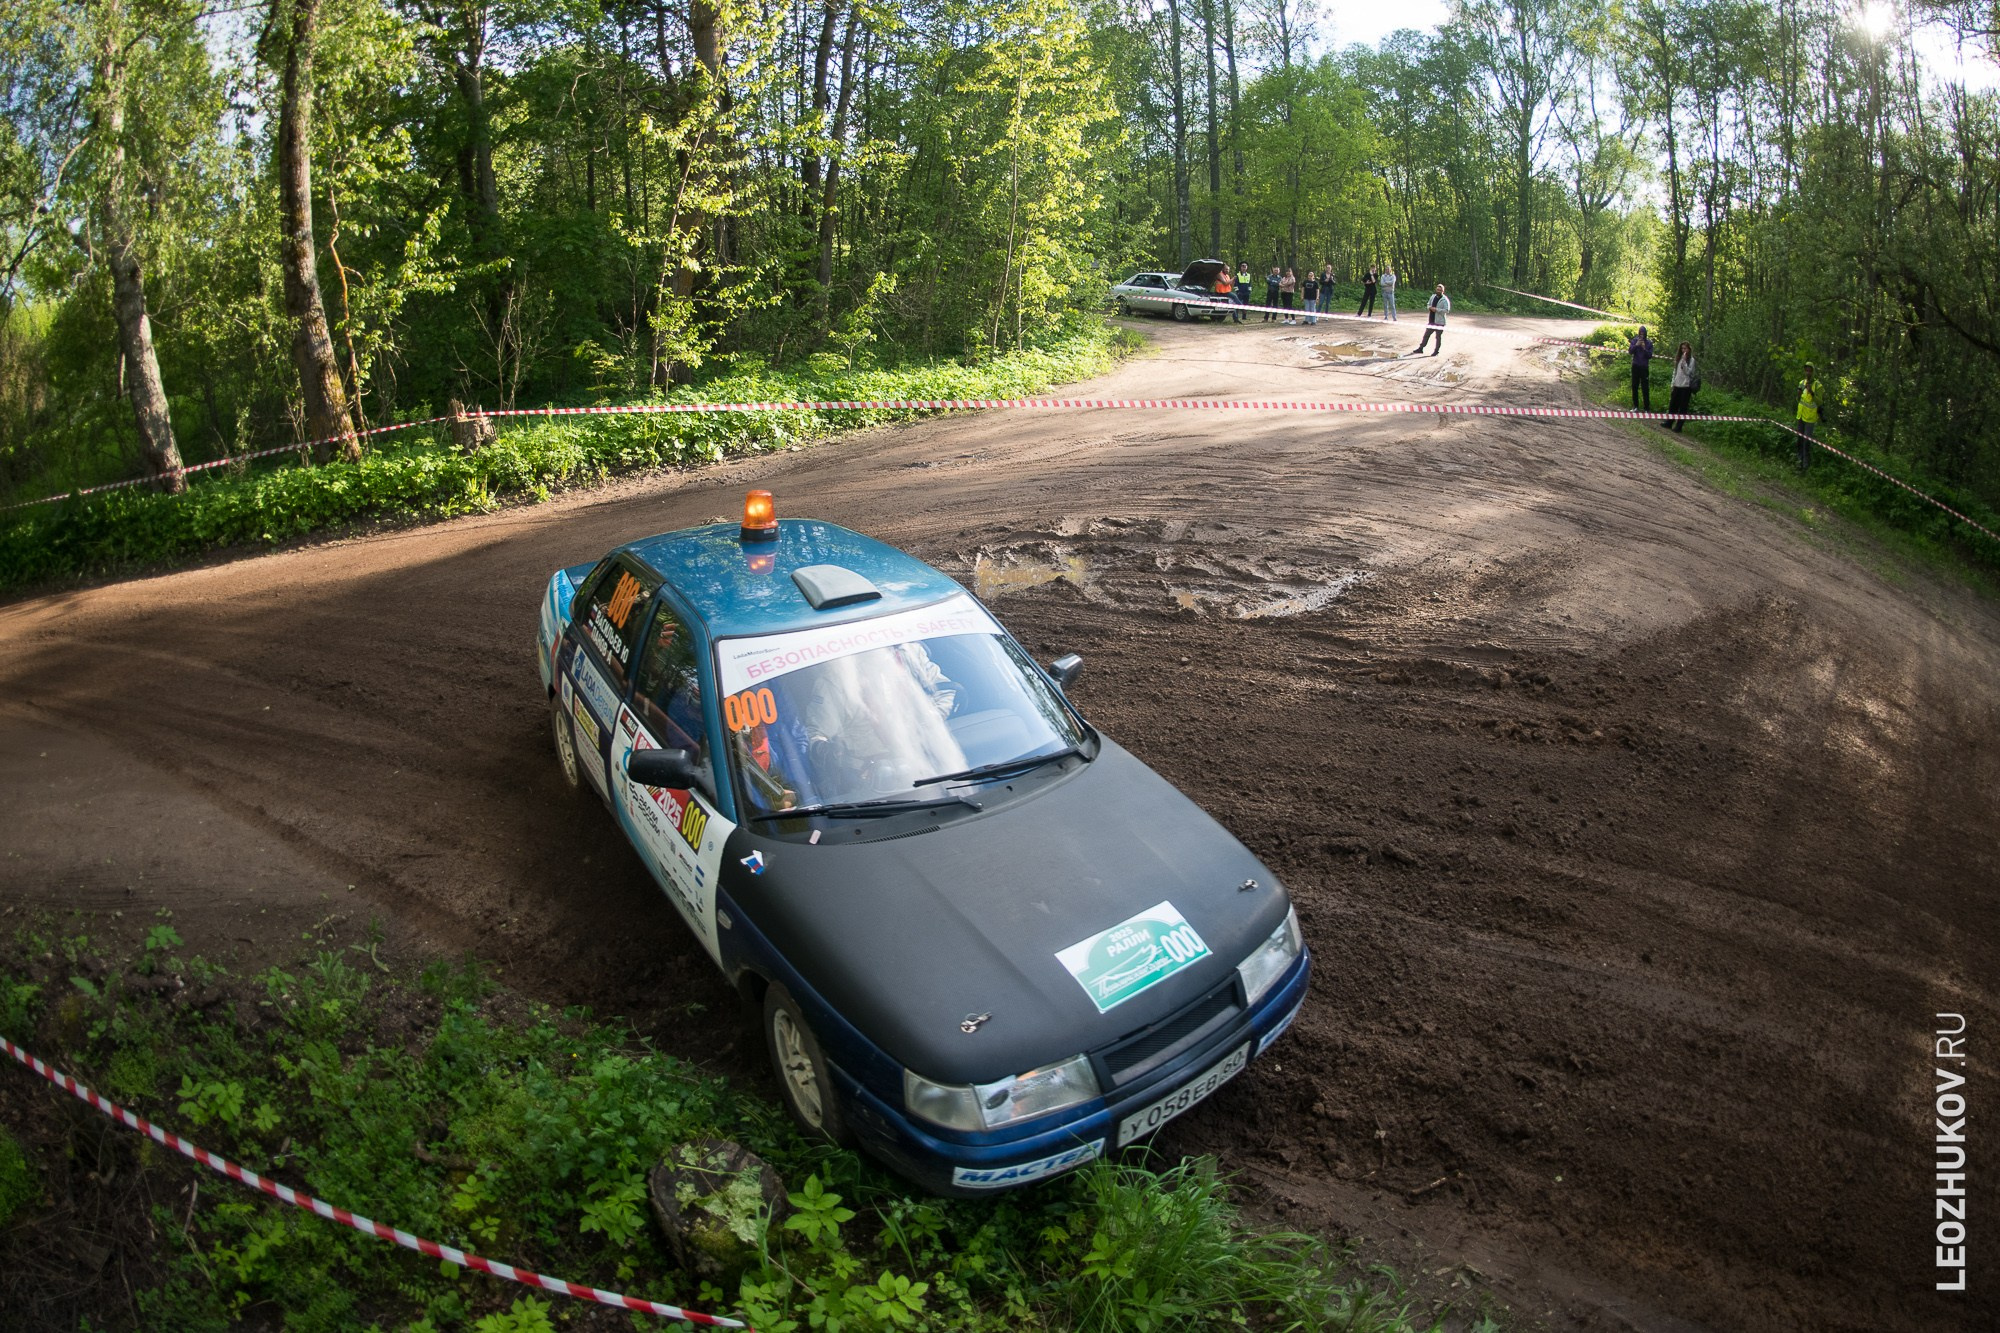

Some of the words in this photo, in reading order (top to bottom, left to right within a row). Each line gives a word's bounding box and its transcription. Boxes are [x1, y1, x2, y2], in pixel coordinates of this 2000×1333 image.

[607, 570, 641, 630] 000
[595, 609, 622, 654] ВАСИЛЬЕВ
[620, 645, 629, 663] Ю
[606, 649, 613, 665] А
[746, 627, 904, 679] БЕЗОПАСНОСТЬ
[916, 618, 975, 634] SAFETY
[724, 687, 778, 732] 000
[657, 787, 683, 828] 2025
[682, 800, 707, 849] 000
[1106, 929, 1151, 957] РАЛЛИ
[1108, 926, 1134, 943] 2025
[1160, 925, 1205, 963] 000
